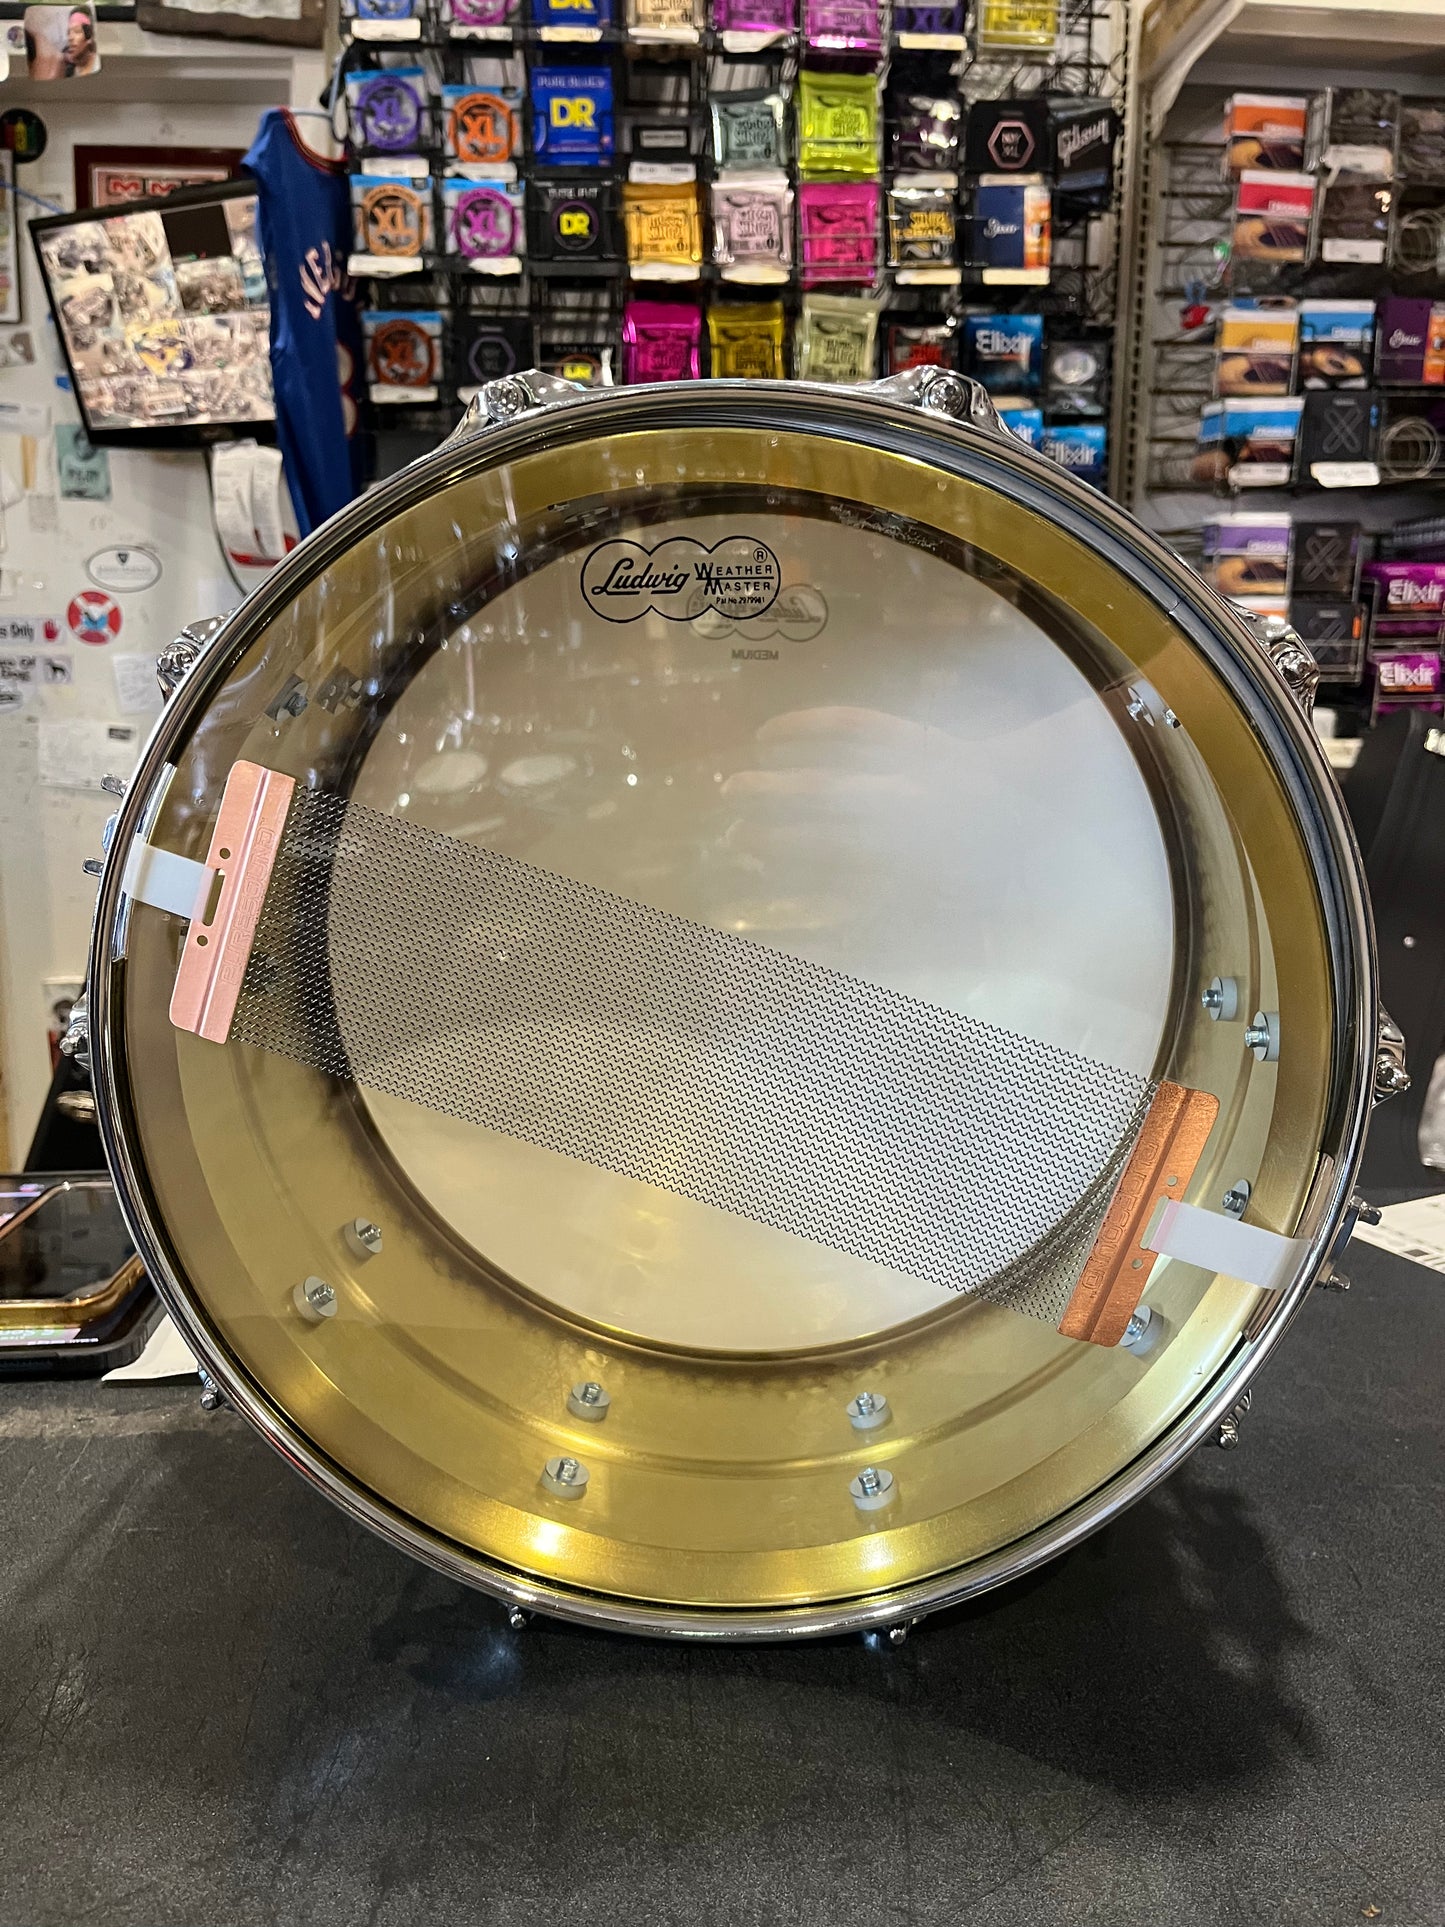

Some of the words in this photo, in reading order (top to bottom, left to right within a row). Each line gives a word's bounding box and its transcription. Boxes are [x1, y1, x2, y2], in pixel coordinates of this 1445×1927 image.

[549, 97, 596, 128] DR
[559, 212, 590, 237] DR
[975, 329, 1034, 357] Elixir
[591, 557, 690, 596] Ludwig
[704, 578, 771, 596] MASTER
[1387, 578, 1444, 605] Elixir
[10, 622, 34, 642] Only
[1380, 661, 1436, 687] Elixir
[217, 827, 276, 987] PURESOUND
[1082, 1141, 1158, 1291] PURESOUND
